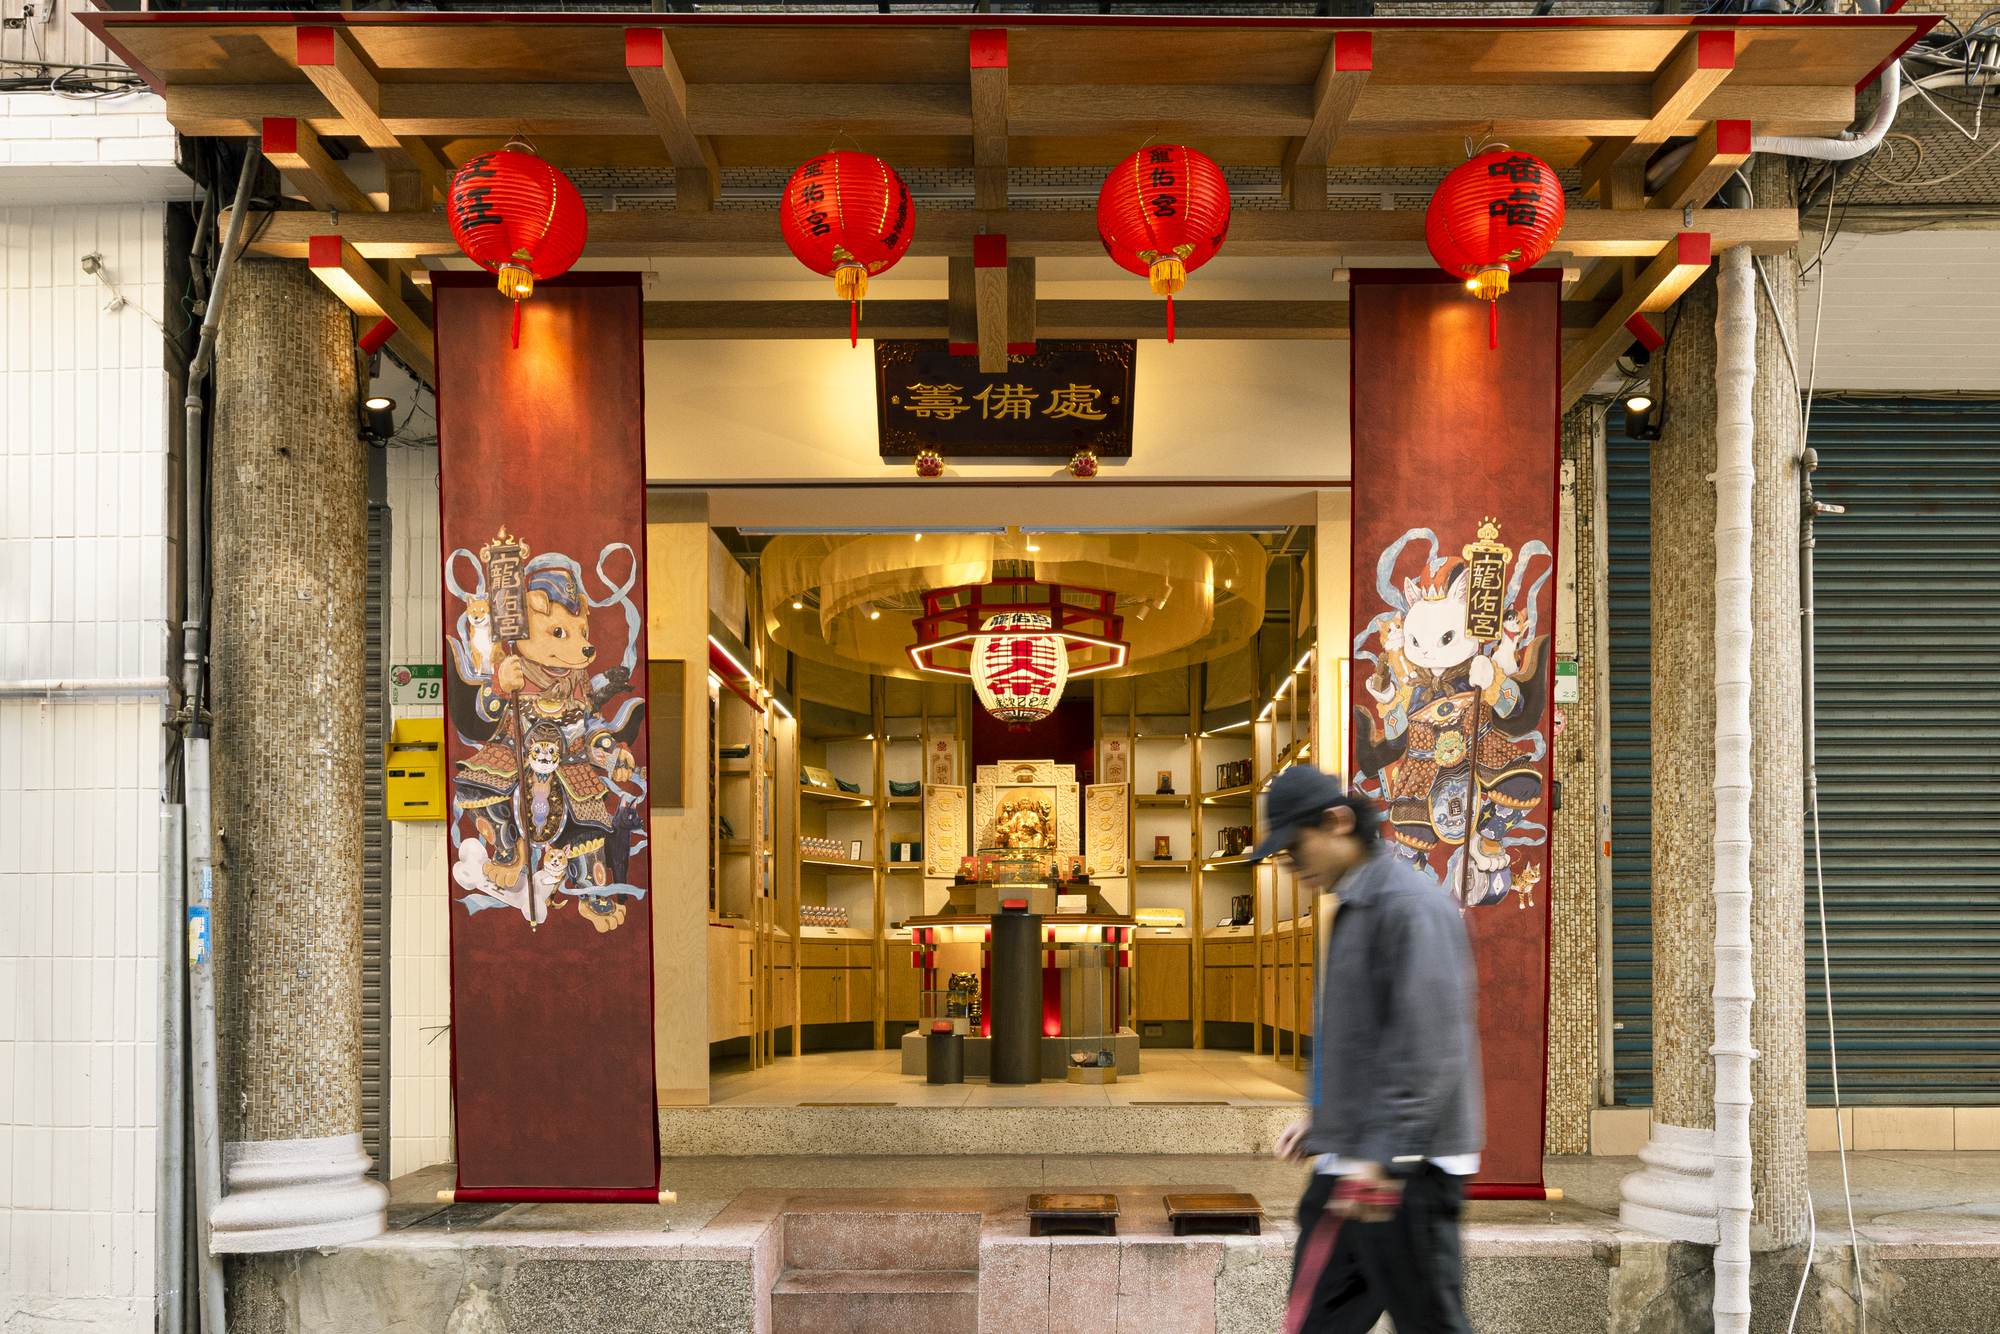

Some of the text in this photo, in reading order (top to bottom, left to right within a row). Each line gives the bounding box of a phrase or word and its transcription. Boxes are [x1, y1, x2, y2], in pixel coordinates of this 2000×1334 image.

[455, 154, 503, 232] 汪汪
[1488, 155, 1541, 227] 喵喵
[904, 382, 1107, 421] 籌備處
[417, 682, 441, 699] 59
